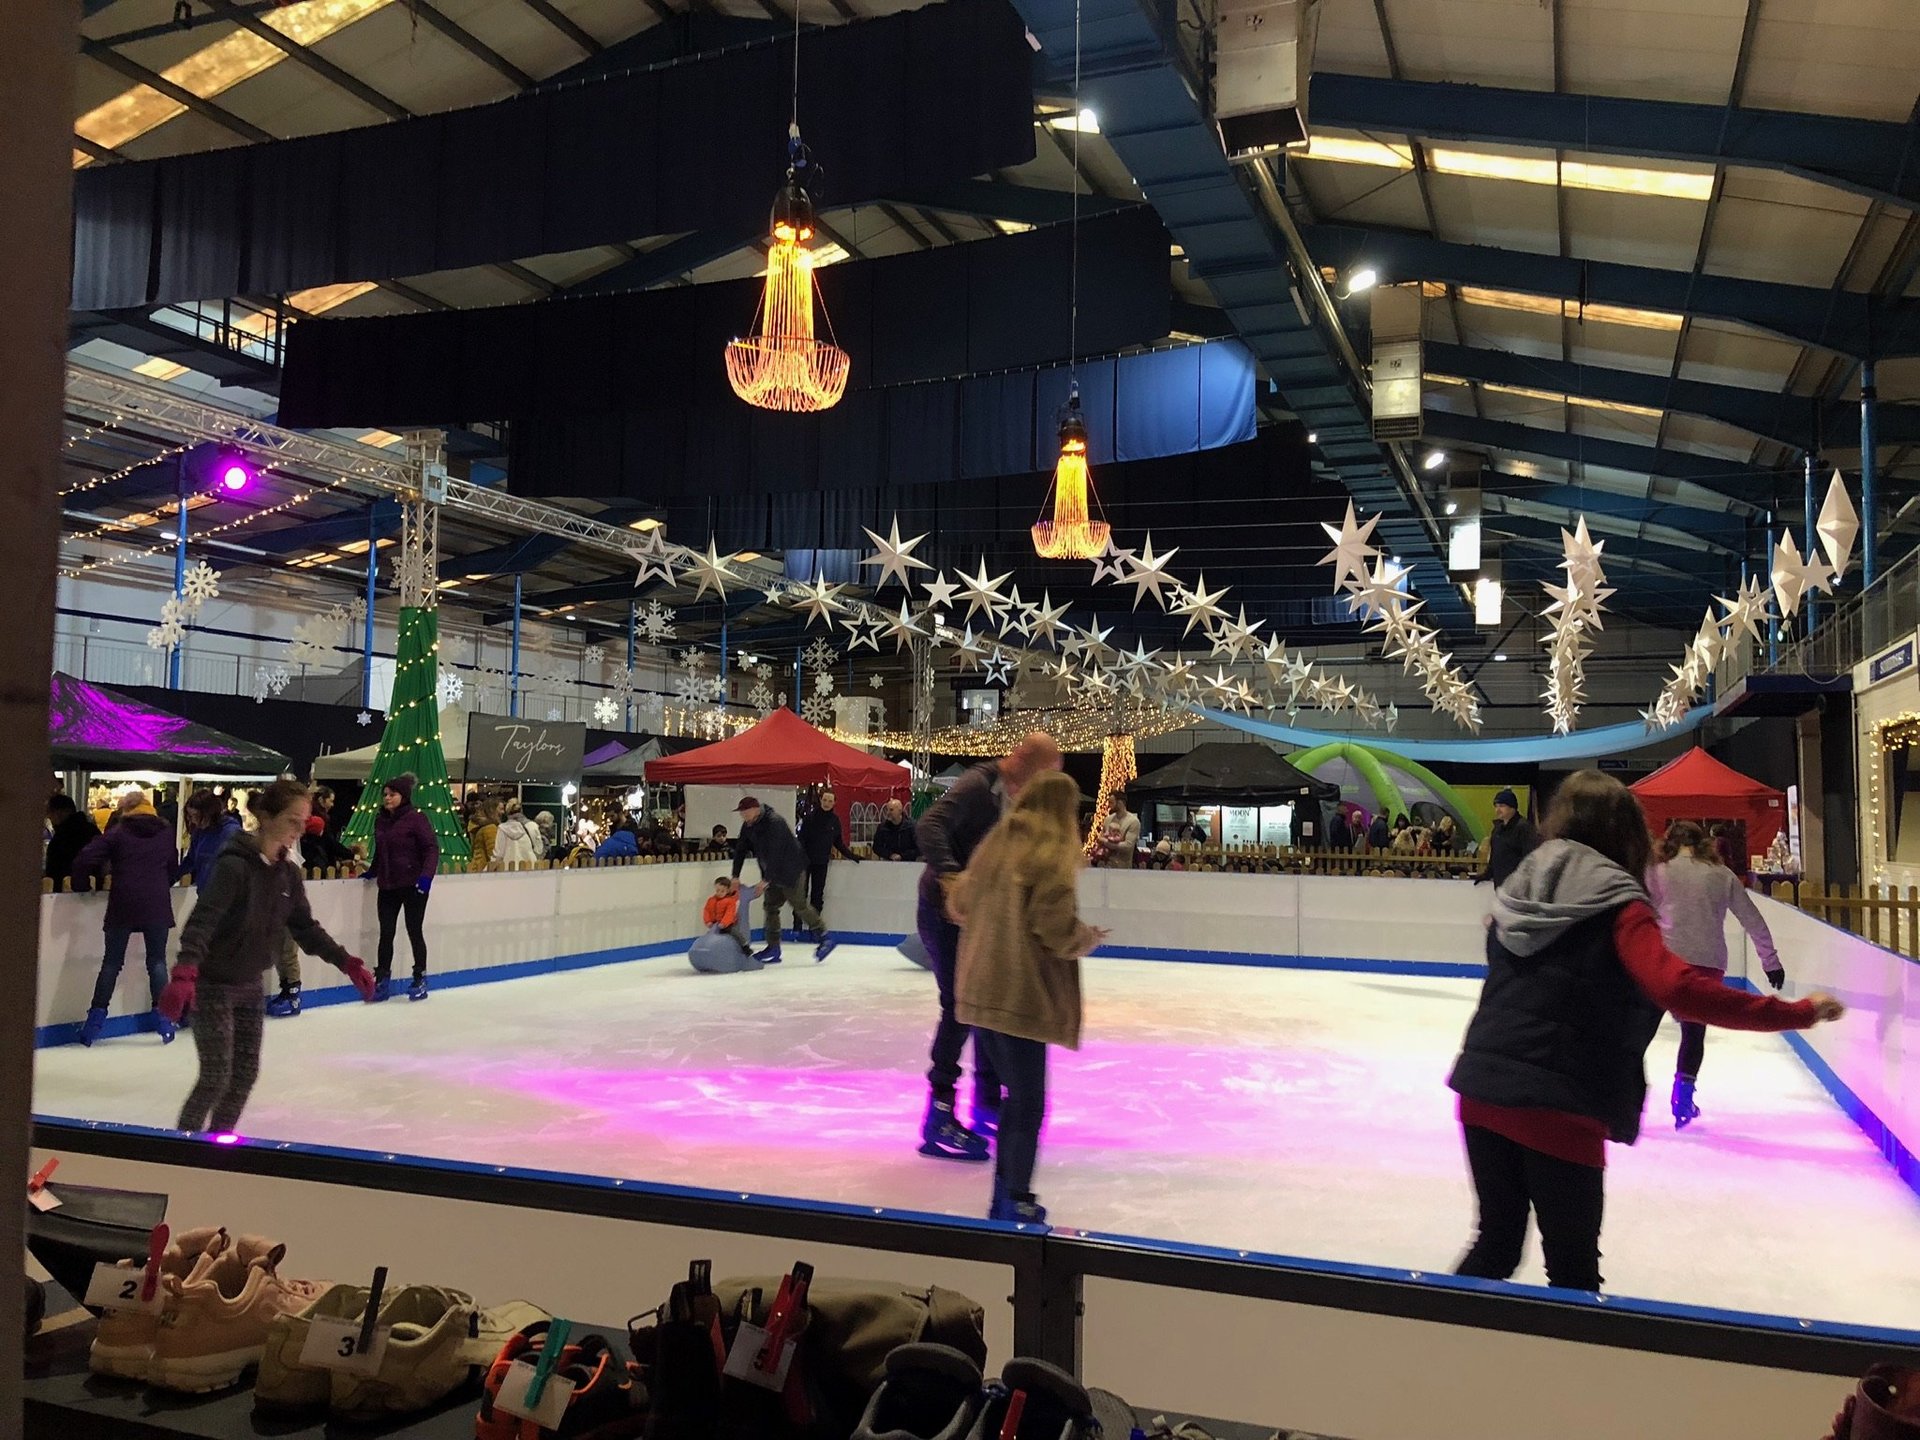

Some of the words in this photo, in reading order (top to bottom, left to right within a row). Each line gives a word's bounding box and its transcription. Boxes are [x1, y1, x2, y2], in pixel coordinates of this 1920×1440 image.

[495, 724, 565, 773] Taylors
[1230, 809, 1250, 817] MOON
[119, 1280, 138, 1299] 2
[337, 1336, 355, 1357] 3
